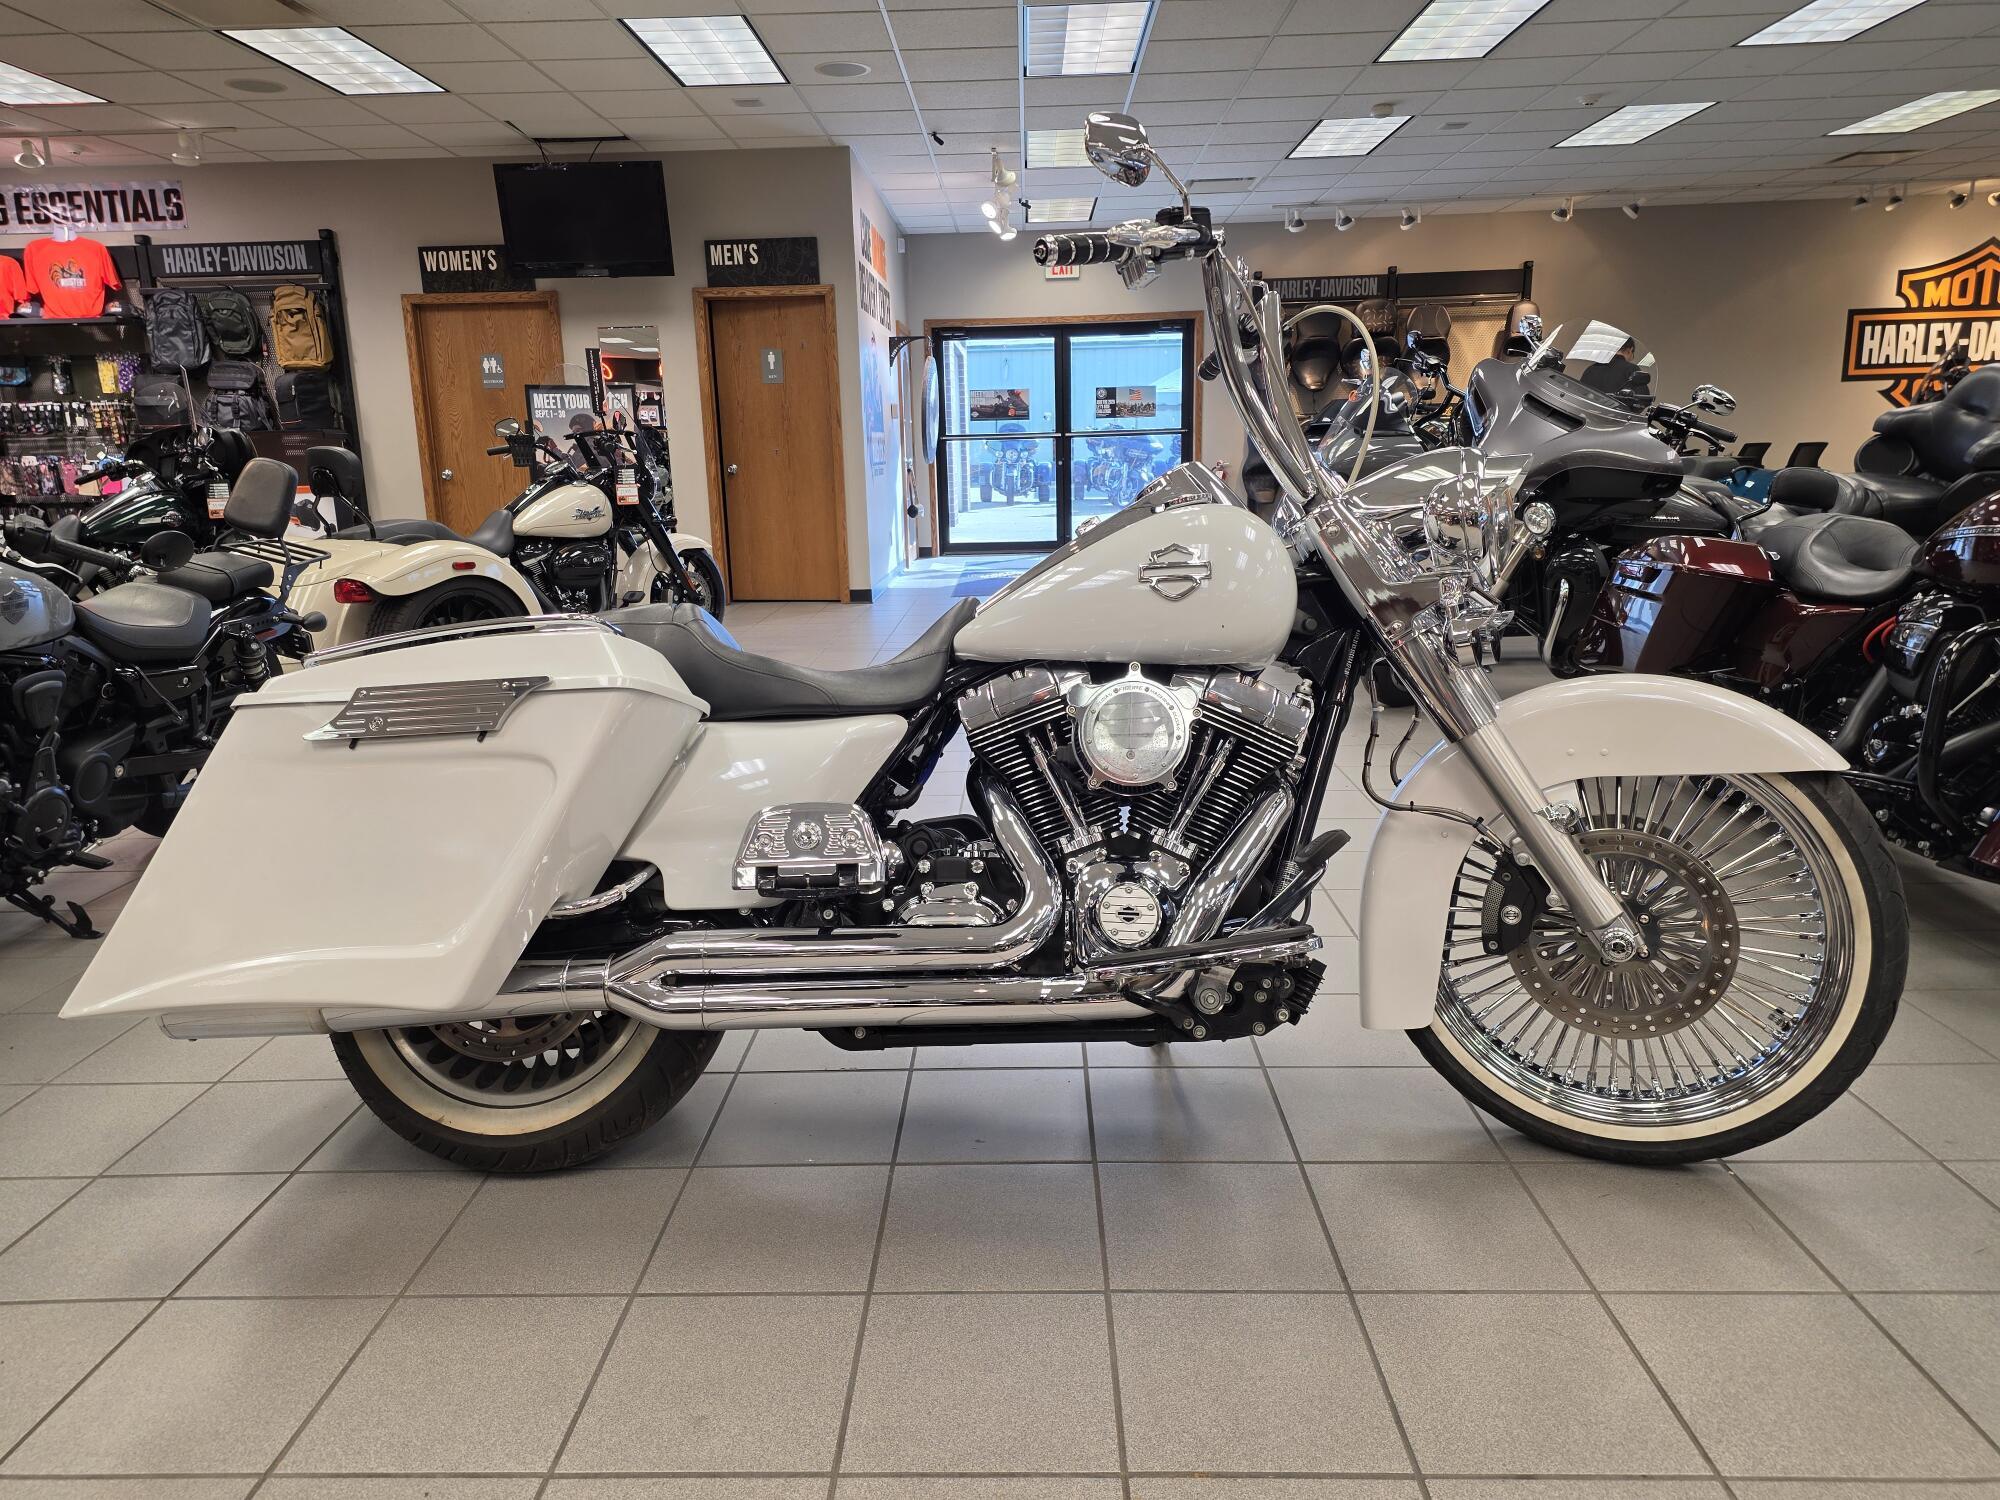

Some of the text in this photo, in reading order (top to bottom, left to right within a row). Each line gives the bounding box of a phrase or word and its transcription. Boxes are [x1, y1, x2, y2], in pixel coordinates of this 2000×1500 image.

[14, 188, 184, 225] ESSENTIALS
[162, 244, 308, 274] HARLEY-DAVIDSON
[423, 249, 498, 272] WOMEN'S
[710, 243, 759, 266] MEN'S
[1273, 277, 1378, 299] HARLEY-DAVIDSON
[1923, 258, 2000, 308] MOT
[533, 393, 561, 409] MEET
[561, 392, 591, 409] YOUR
[558, 409, 566, 418] 30
